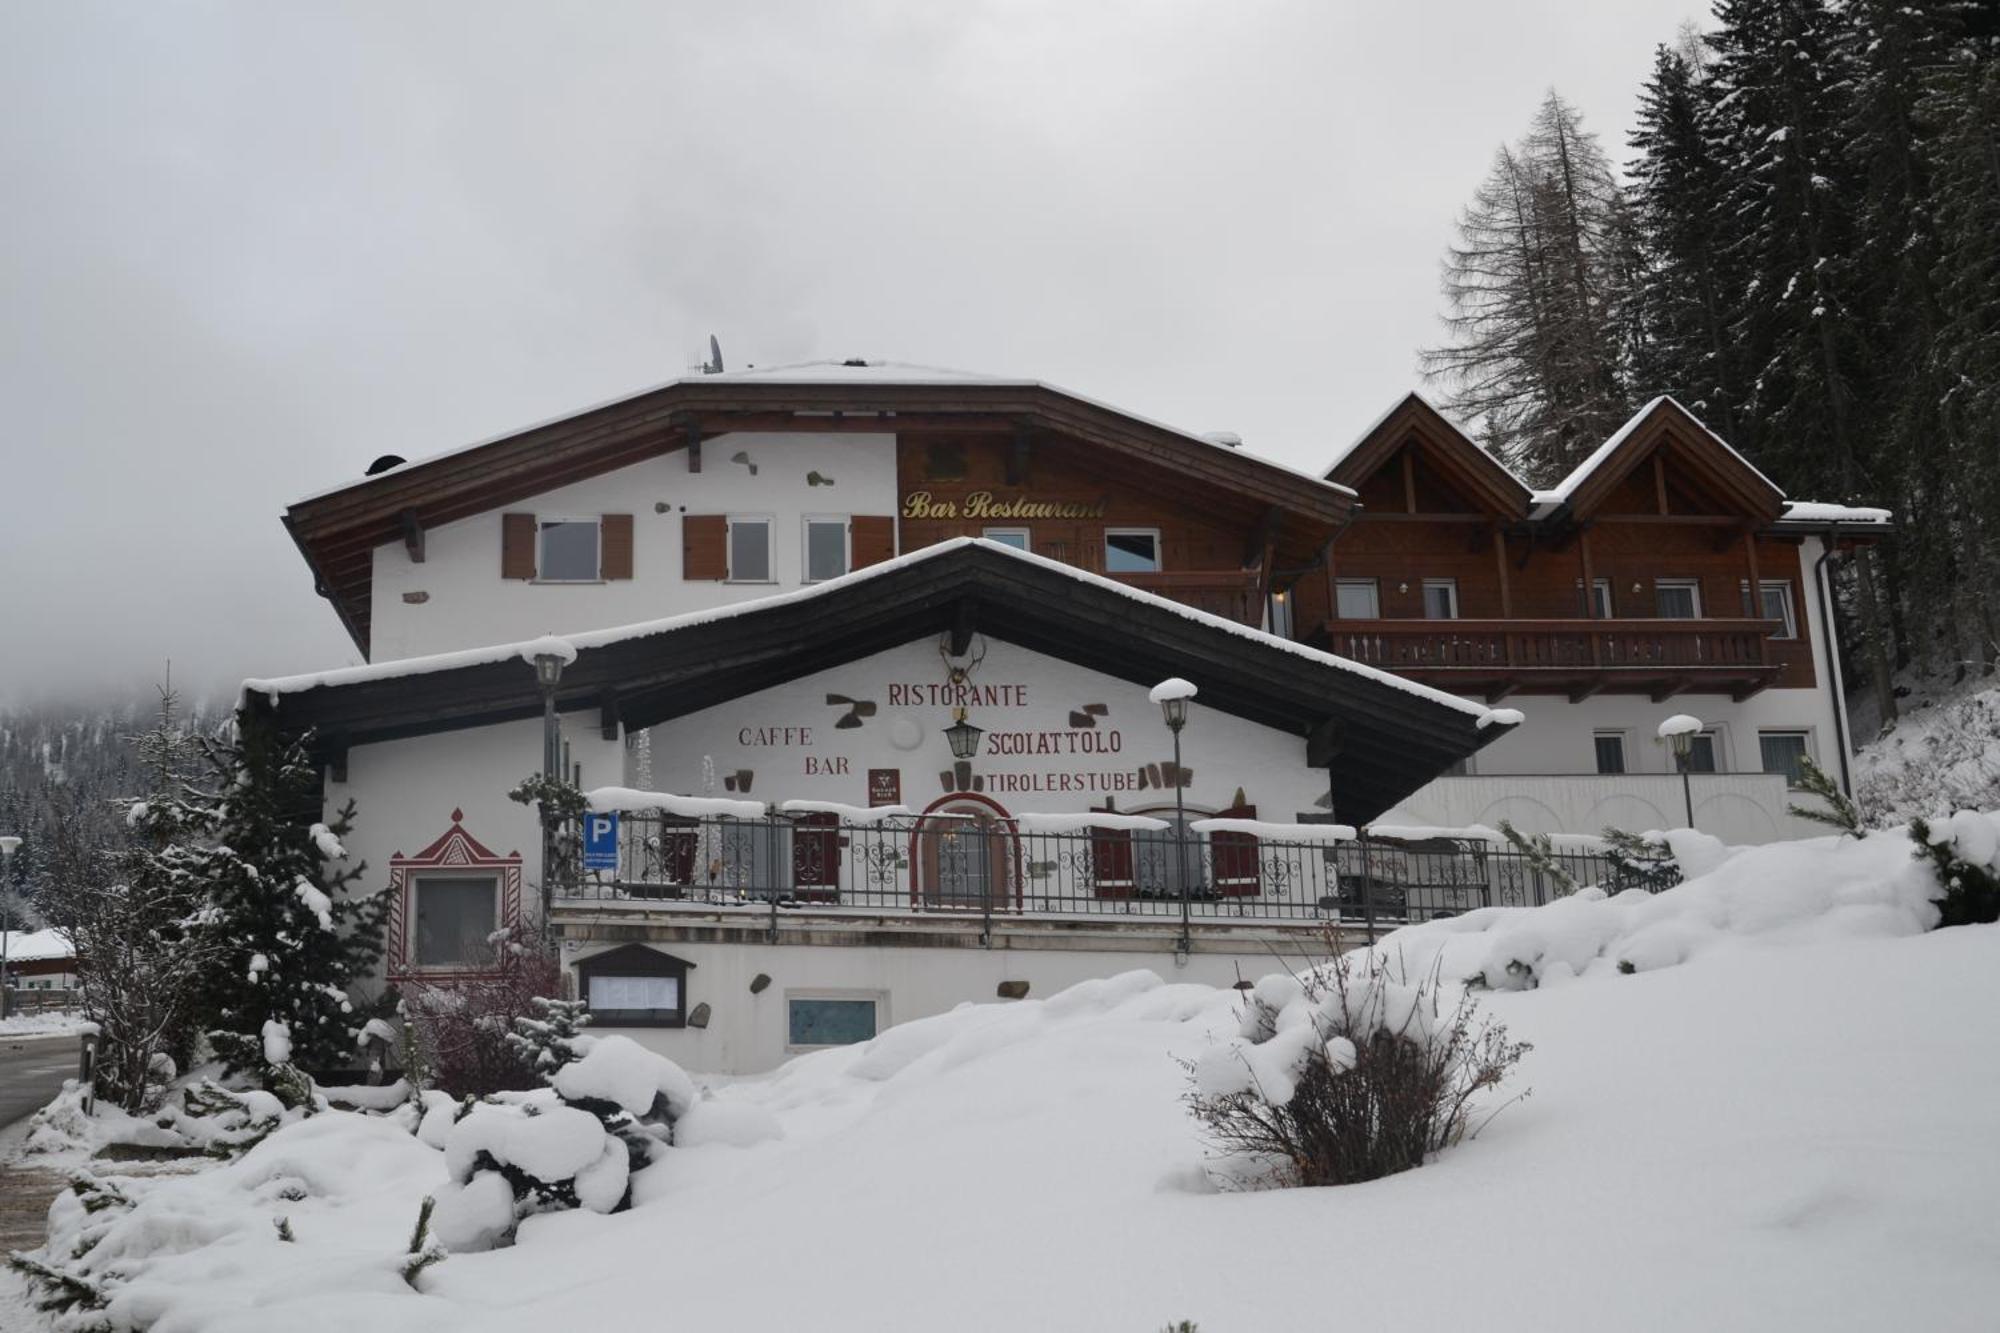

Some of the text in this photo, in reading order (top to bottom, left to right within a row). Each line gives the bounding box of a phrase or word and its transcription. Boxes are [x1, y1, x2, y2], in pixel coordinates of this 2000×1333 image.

[903, 491, 1107, 518] Bar Restaurant
[889, 684, 1027, 706] RISTORANTE
[739, 727, 812, 746] CAFFE
[988, 731, 1121, 754] SCOIATTOLO
[806, 756, 849, 775] BAR
[989, 774, 1137, 792] TIROLERSTUBE
[592, 818, 612, 843] P
